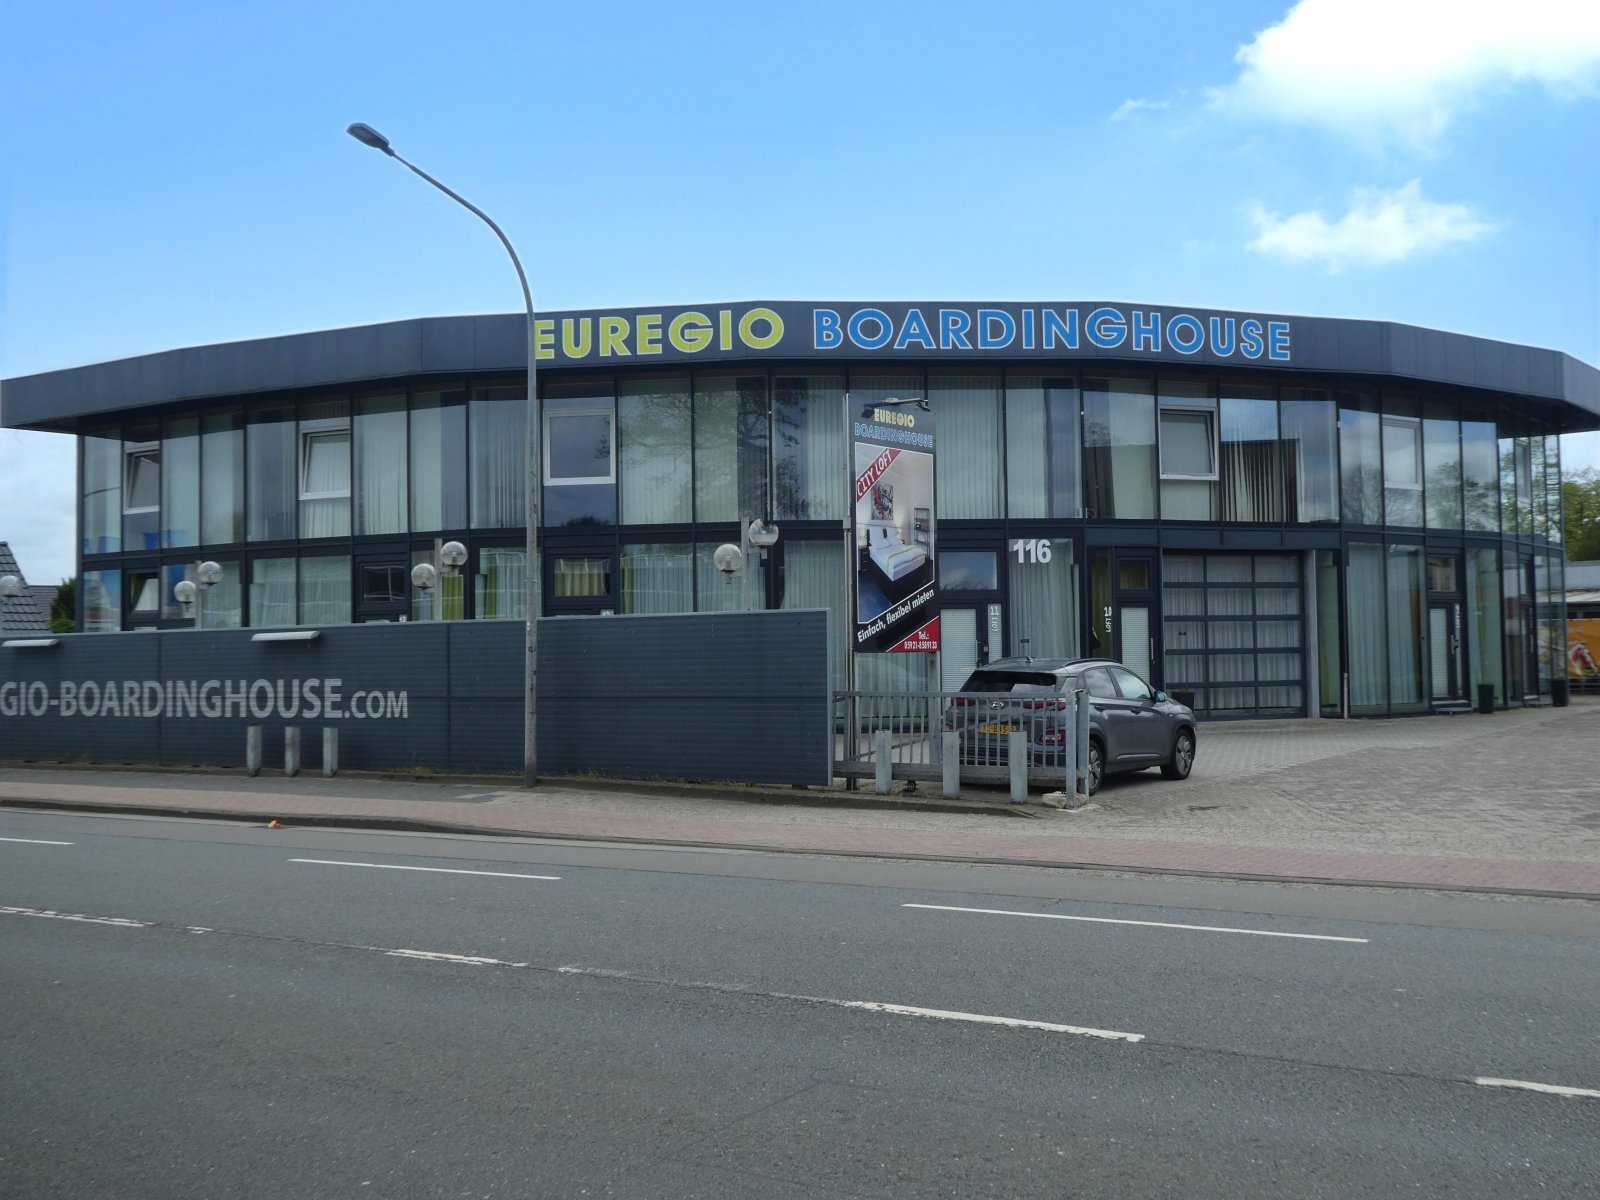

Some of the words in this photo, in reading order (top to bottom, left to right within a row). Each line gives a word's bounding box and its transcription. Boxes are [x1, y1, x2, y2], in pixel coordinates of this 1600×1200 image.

[534, 307, 785, 360] EUREGIO
[813, 307, 1291, 361] BOARDINGHOUSE
[854, 422, 933, 448] BOARDINGHOUSE
[874, 408, 915, 427] EUREGIO
[857, 467, 875, 496] CITY
[874, 449, 893, 476] LOFT
[1013, 539, 1052, 564] 116
[857, 619, 886, 643] Einfach,
[886, 601, 911, 625] flexibel
[912, 589, 934, 609] mieten
